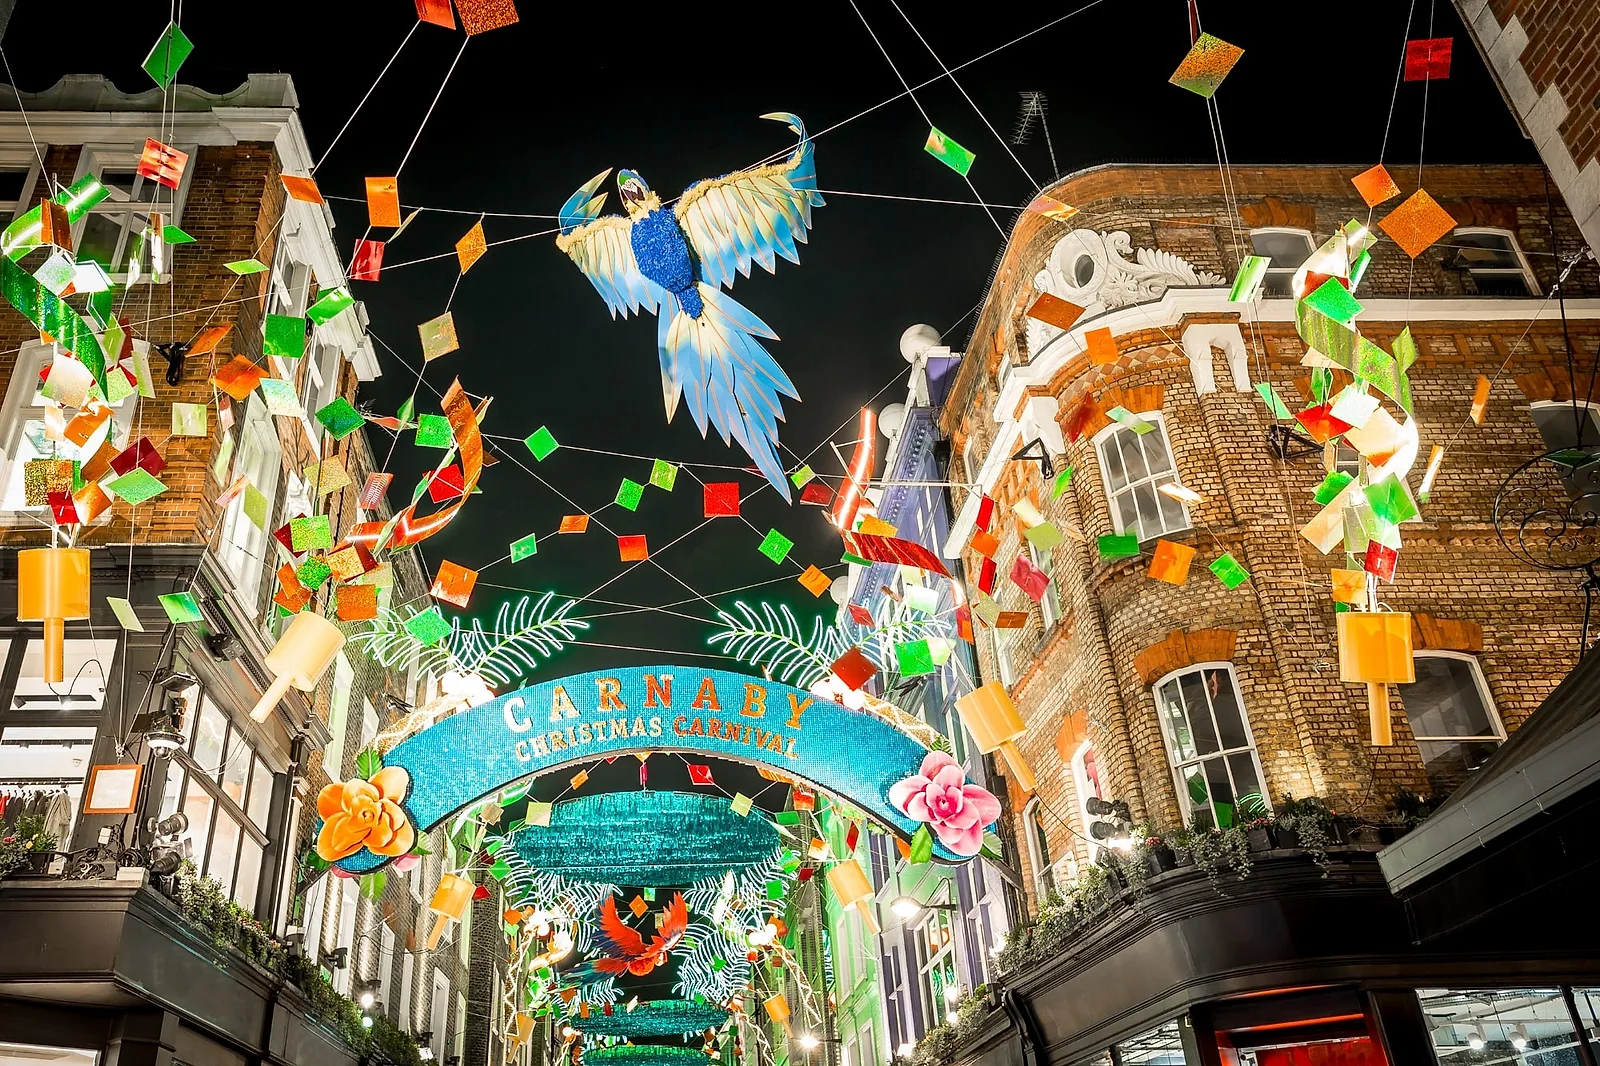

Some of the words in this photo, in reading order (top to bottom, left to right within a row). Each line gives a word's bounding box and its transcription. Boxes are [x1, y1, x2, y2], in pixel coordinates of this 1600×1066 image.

[504, 674, 814, 732] CARNABY
[515, 715, 661, 762] CHRISTMAS
[673, 715, 799, 759] CARNIVAL
